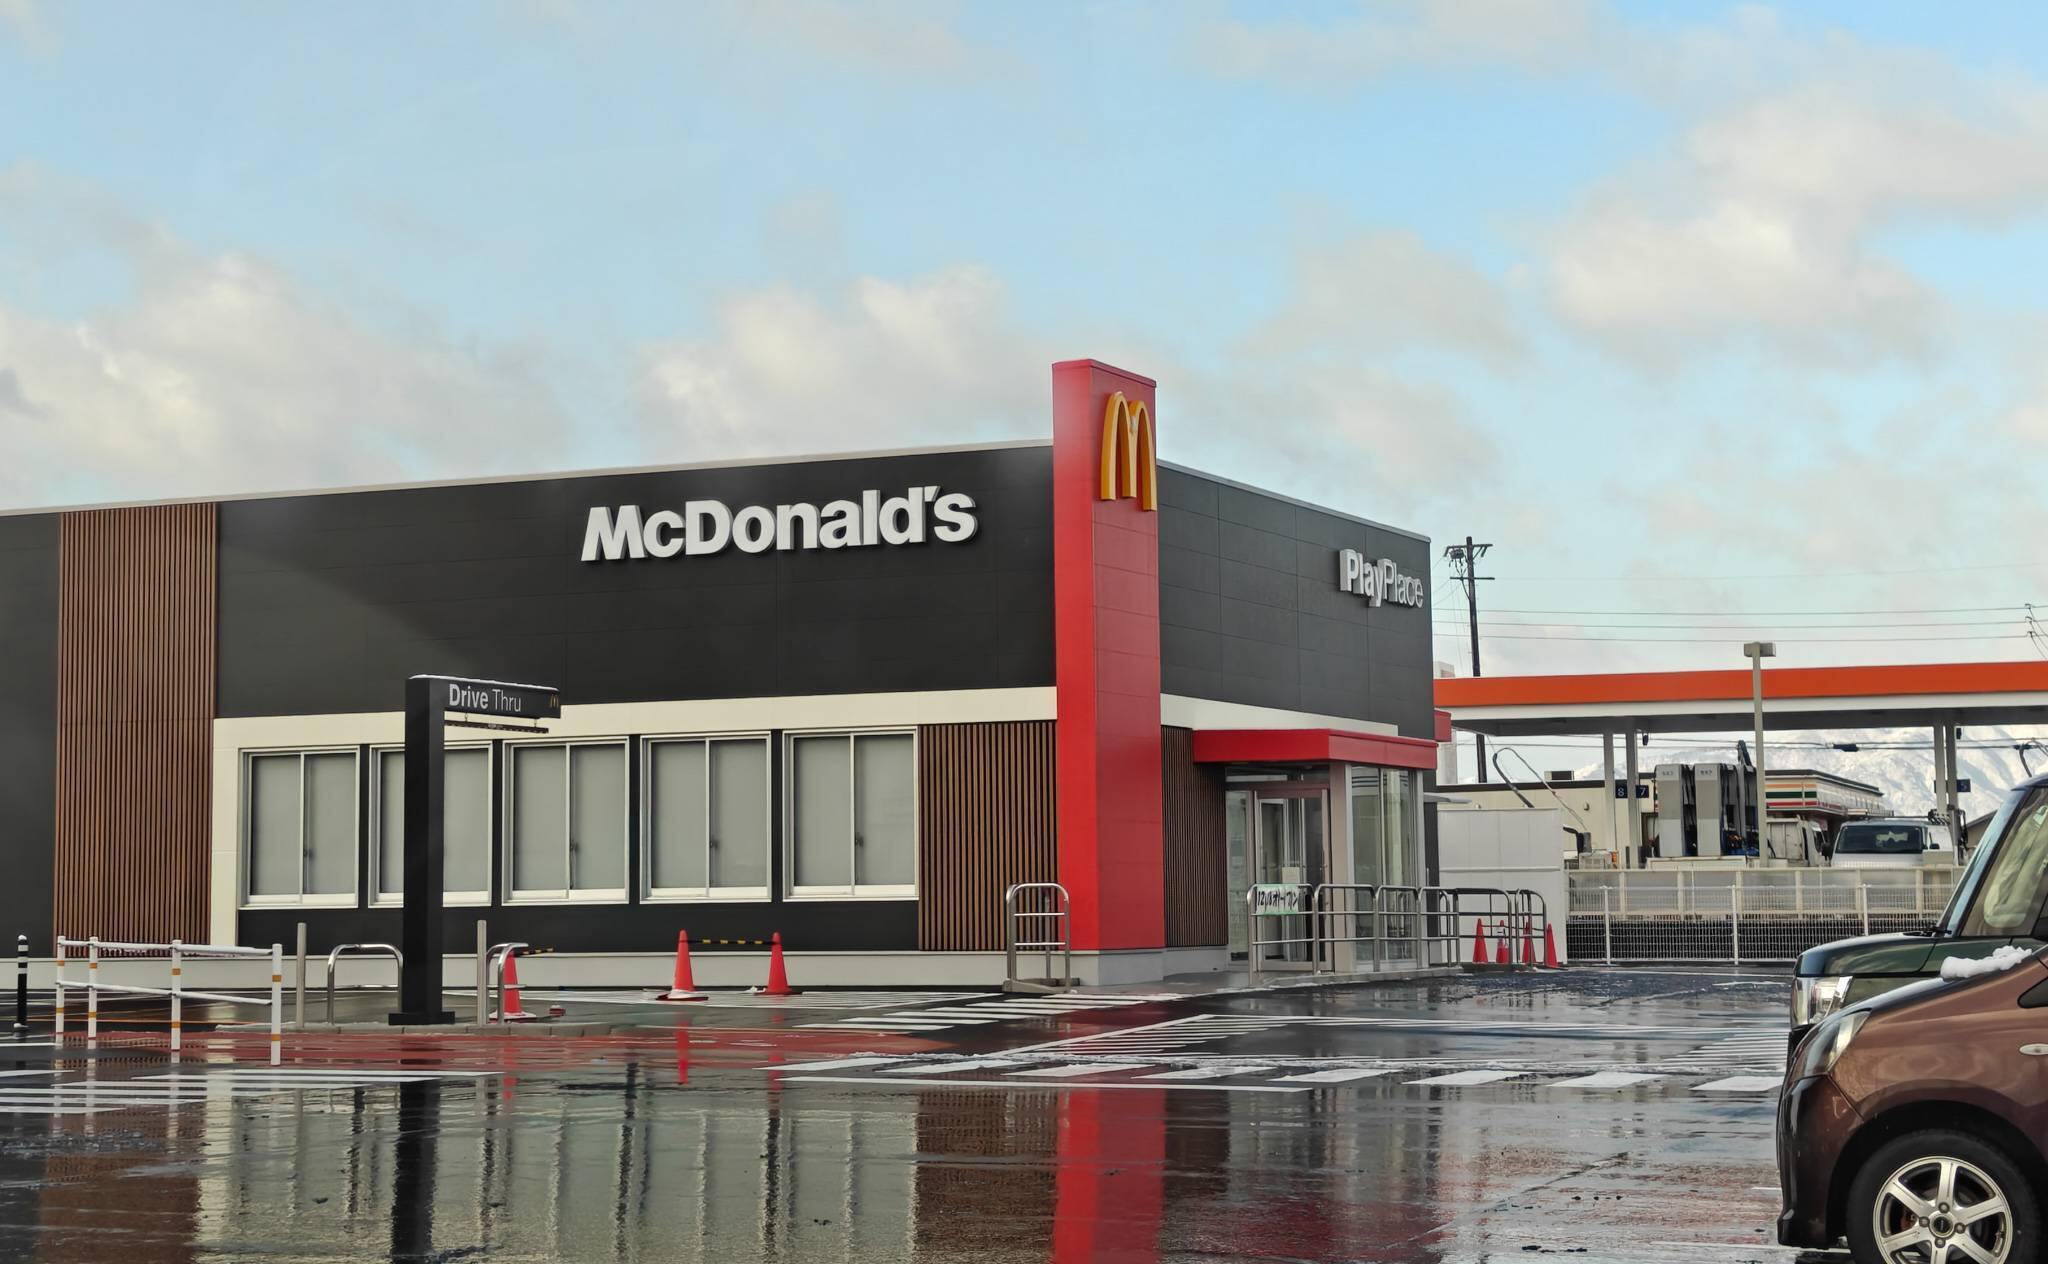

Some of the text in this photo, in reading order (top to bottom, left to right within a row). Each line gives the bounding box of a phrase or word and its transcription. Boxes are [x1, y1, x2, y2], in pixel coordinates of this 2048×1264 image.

[580, 485, 978, 562] McDonald's
[1340, 548, 1424, 608] PlayPlace
[449, 683, 522, 712] Drive Thru
[1617, 787, 1624, 797] 8
[1639, 787, 1646, 796] 7
